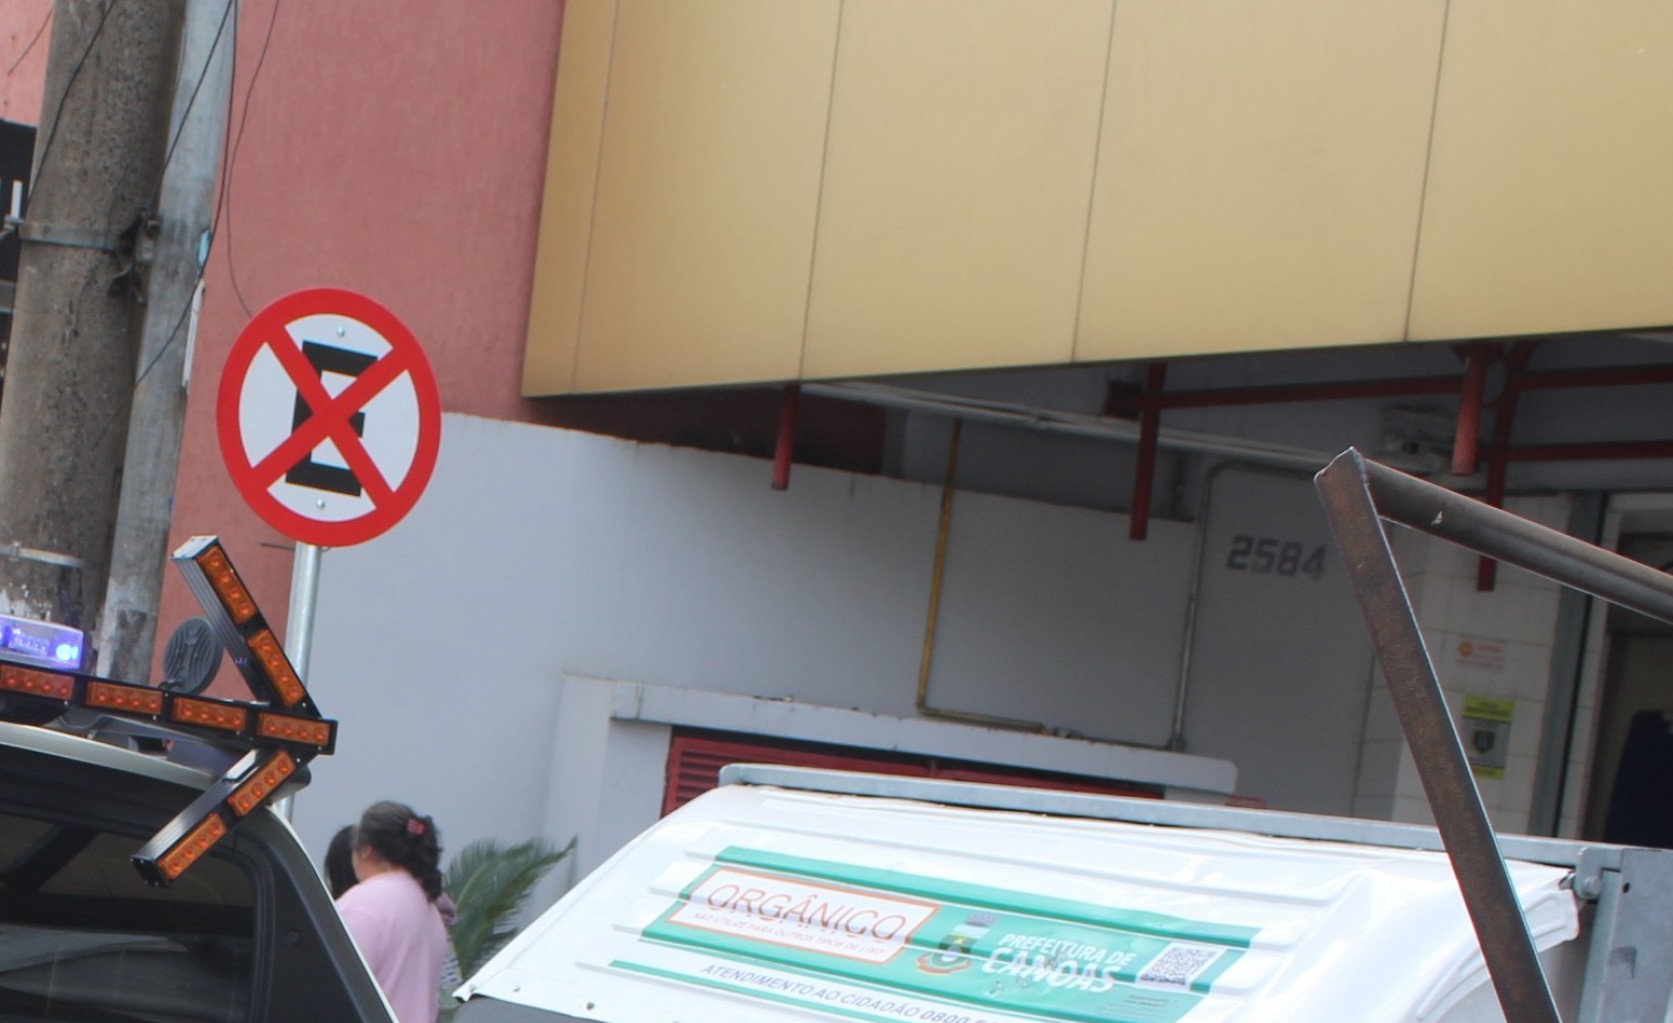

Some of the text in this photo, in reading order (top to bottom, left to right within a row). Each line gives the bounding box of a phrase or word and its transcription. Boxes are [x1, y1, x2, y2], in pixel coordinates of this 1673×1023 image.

[1226, 534, 1327, 579] 2584
[707, 884, 907, 943] ORGÂNICO
[775, 927, 813, 942] OUTROS
[982, 946, 1121, 992] CANOAS
[998, 933, 1137, 966] PREFEITURA DE
[701, 963, 815, 998] ATENDIMENTO
[815, 986, 840, 1002] AO
[840, 992, 921, 1018] CIDADÃO
